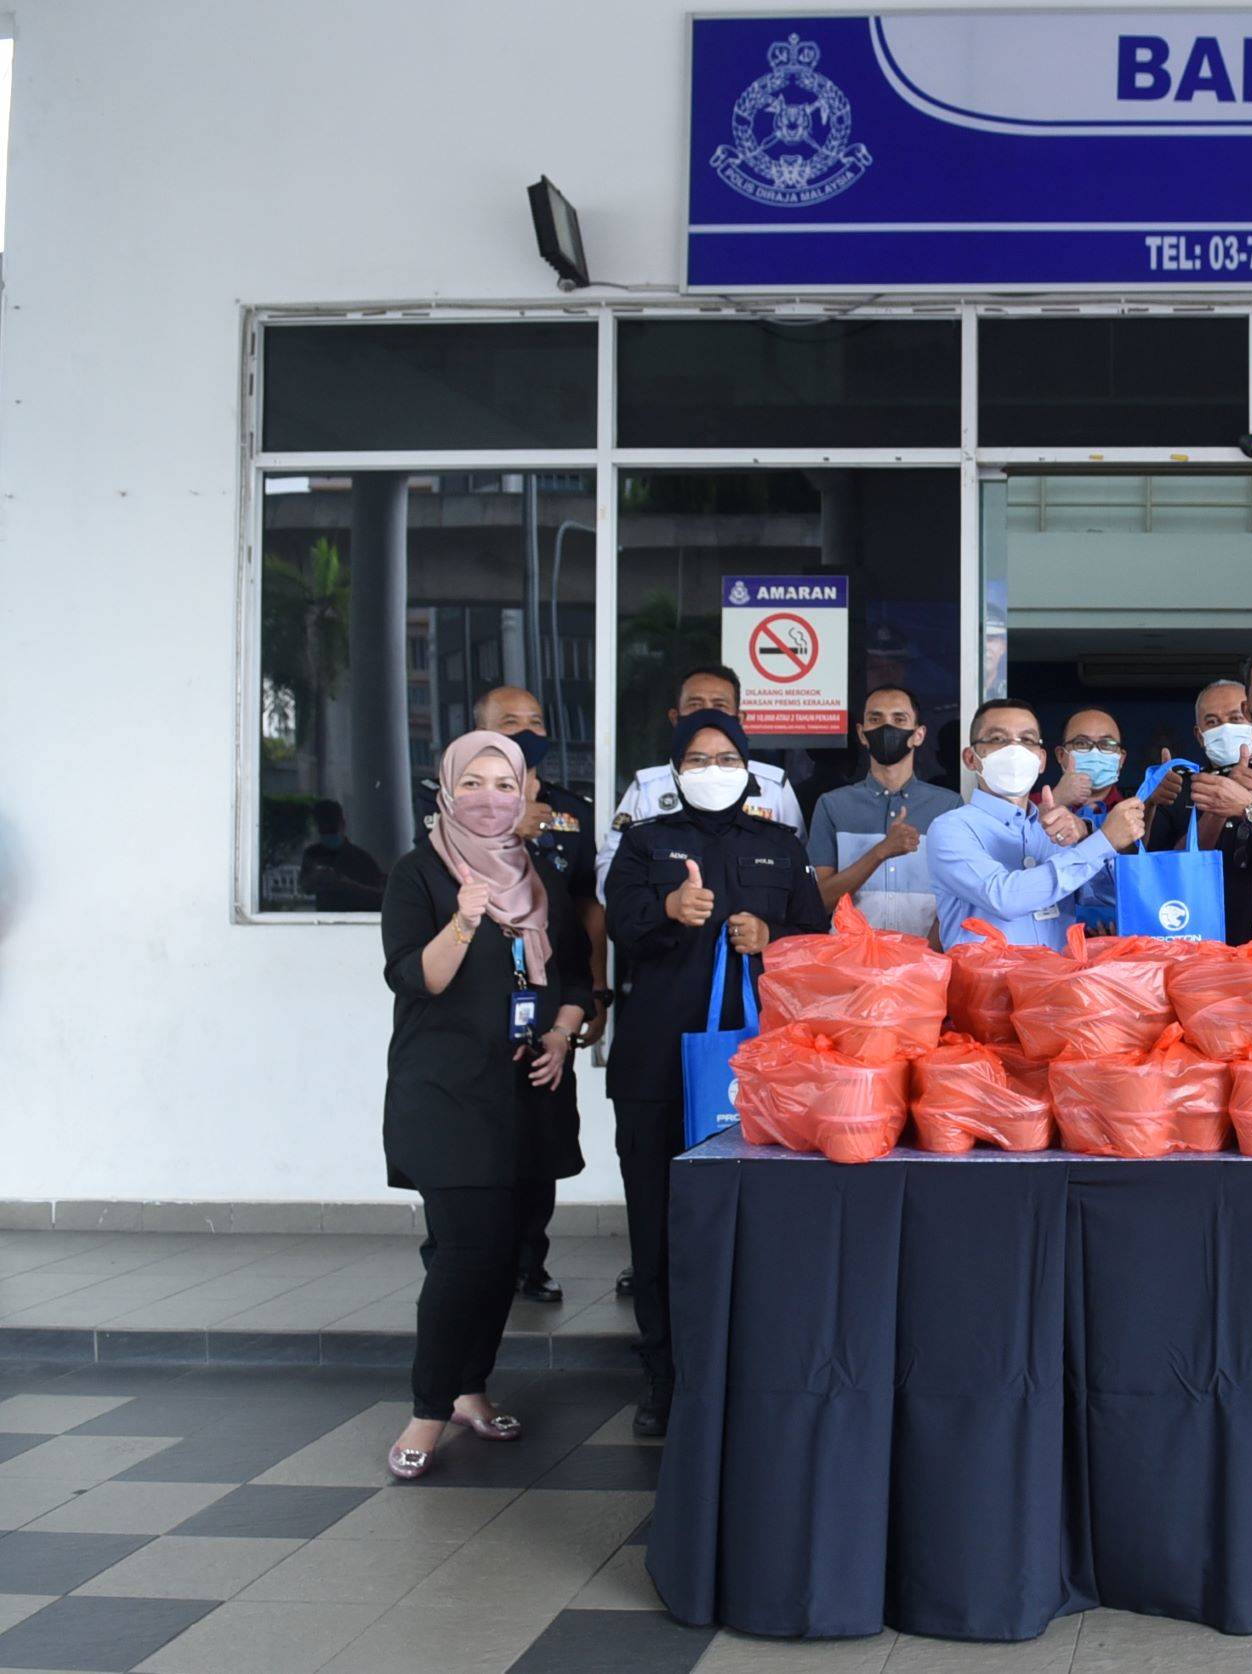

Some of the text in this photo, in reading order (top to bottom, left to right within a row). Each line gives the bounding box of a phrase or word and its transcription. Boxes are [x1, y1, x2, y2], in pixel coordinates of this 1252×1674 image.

[723, 168, 855, 202] POLIS DIRAJA MALAYSIA
[1145, 236, 1202, 270] TEL:
[756, 586, 837, 600] AMARAN
